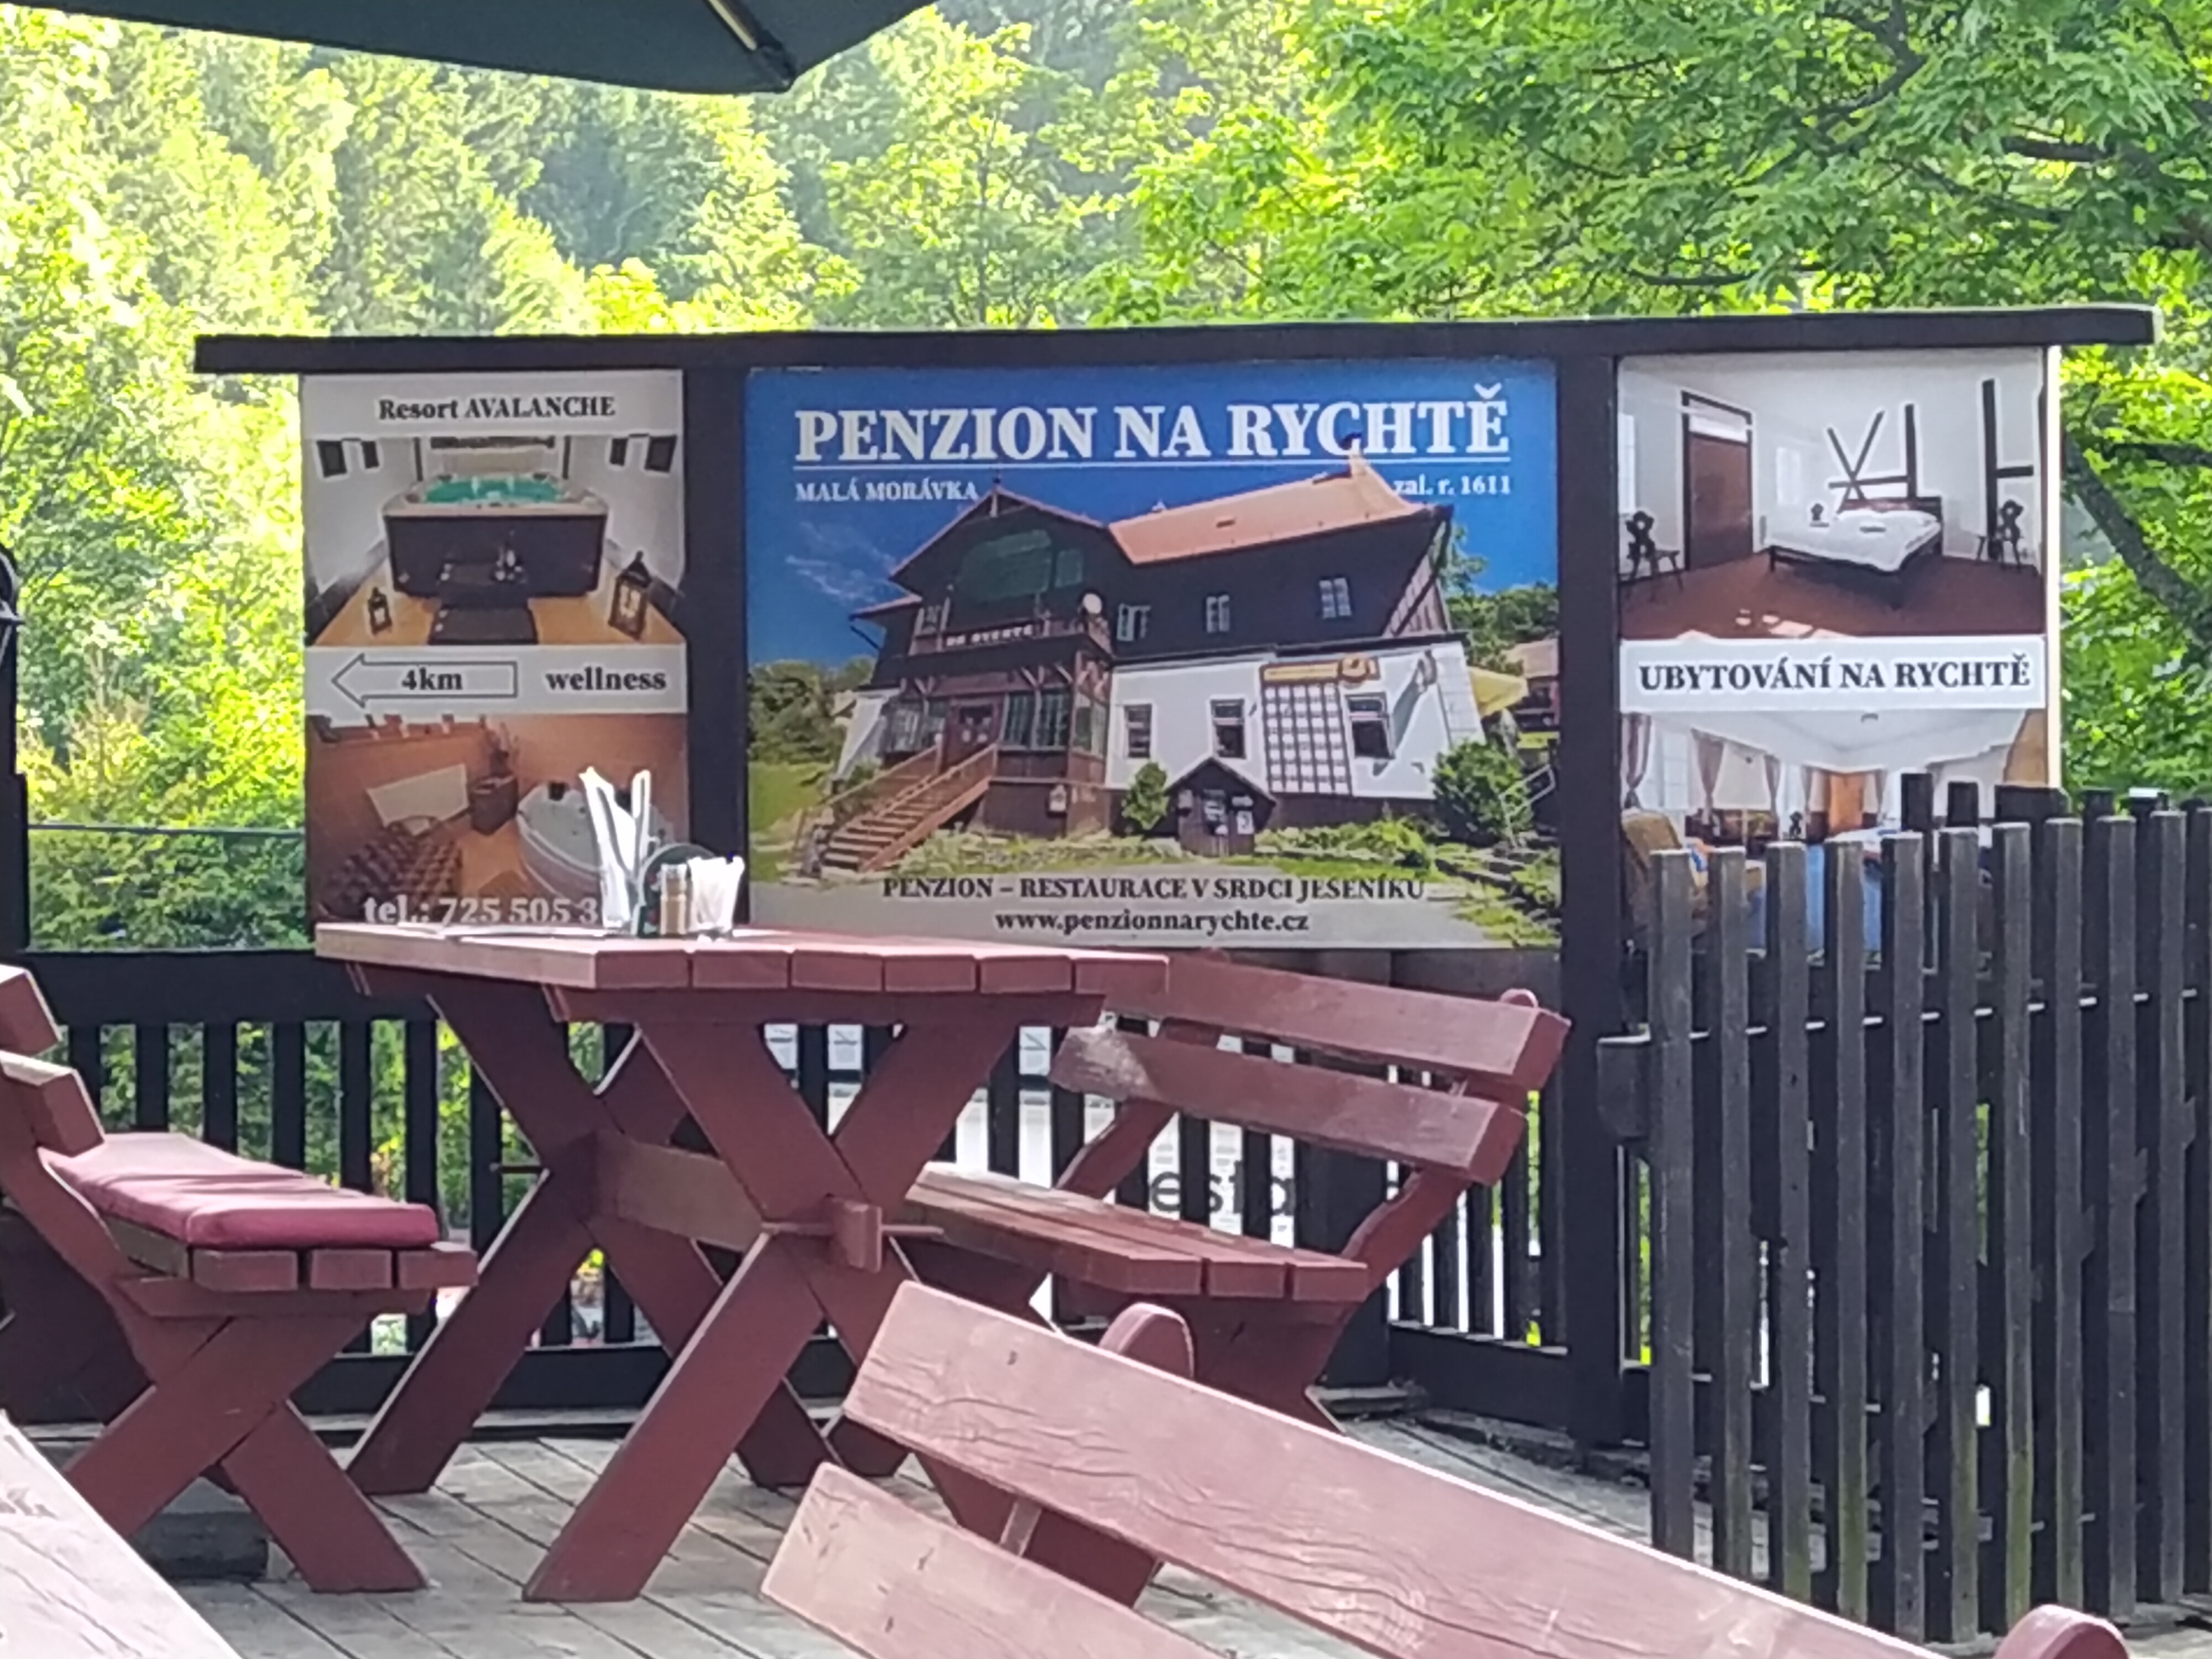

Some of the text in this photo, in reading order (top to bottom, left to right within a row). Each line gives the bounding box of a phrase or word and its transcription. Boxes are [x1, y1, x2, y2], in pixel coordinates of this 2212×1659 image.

[379, 396, 615, 420] Resort AVALANCHE
[795, 383, 1509, 461] PENZION NA RYCHTĚ
[795, 477, 979, 501] MALÁ MORÁVKA
[1393, 475, 1511, 495] zal. r. 1611
[402, 667, 463, 691] 4km
[546, 667, 666, 690] wellness
[1639, 654, 2030, 690] UBYTOVÁNÍ NA RYCHTĚ
[883, 878, 993, 898] PENZION
[1020, 877, 1187, 899] RESTAURACE
[1192, 878, 1209, 899] V
[1213, 878, 1293, 899] SRDCI
[439, 897, 500, 924] 725
[509, 897, 571, 924] 505
[995, 908, 1310, 936] www.penzionnarychte.cz
